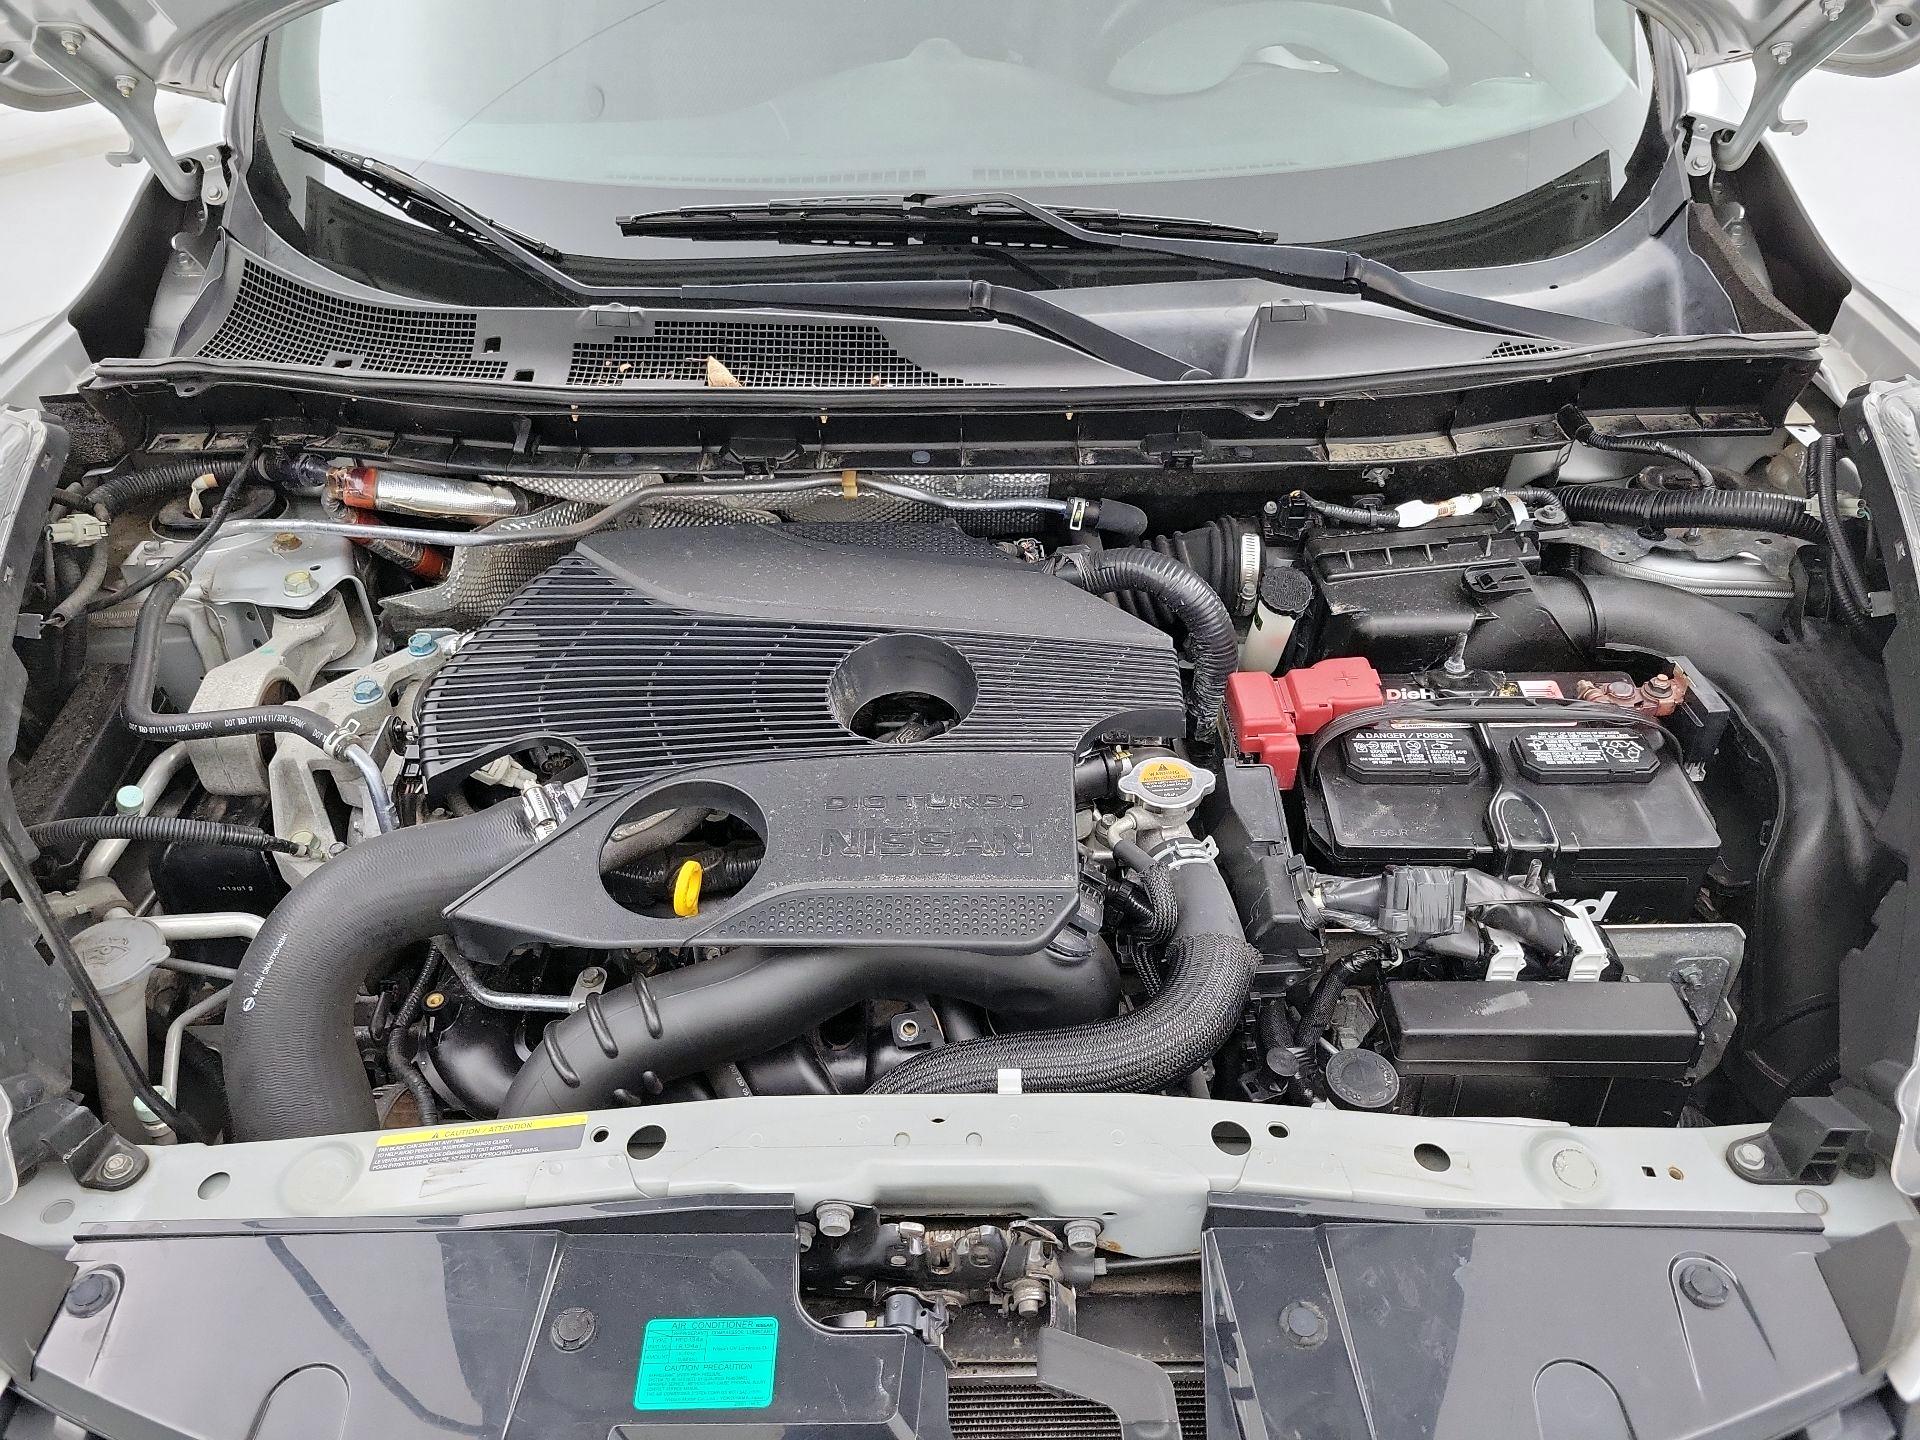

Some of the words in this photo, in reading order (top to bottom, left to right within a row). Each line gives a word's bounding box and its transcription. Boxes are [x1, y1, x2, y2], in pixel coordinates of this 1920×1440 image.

[224, 718, 235, 727] DOT
[897, 793, 1032, 811] TURBO
[820, 827, 1034, 857] NISSAN
[444, 1129, 480, 1138] CAUTION
[489, 1122, 533, 1132] ATTENTION
[671, 1322, 687, 1330] AIR
[691, 1320, 754, 1329] CONDITIONER
[703, 1363, 753, 1371] PRECAUTION
